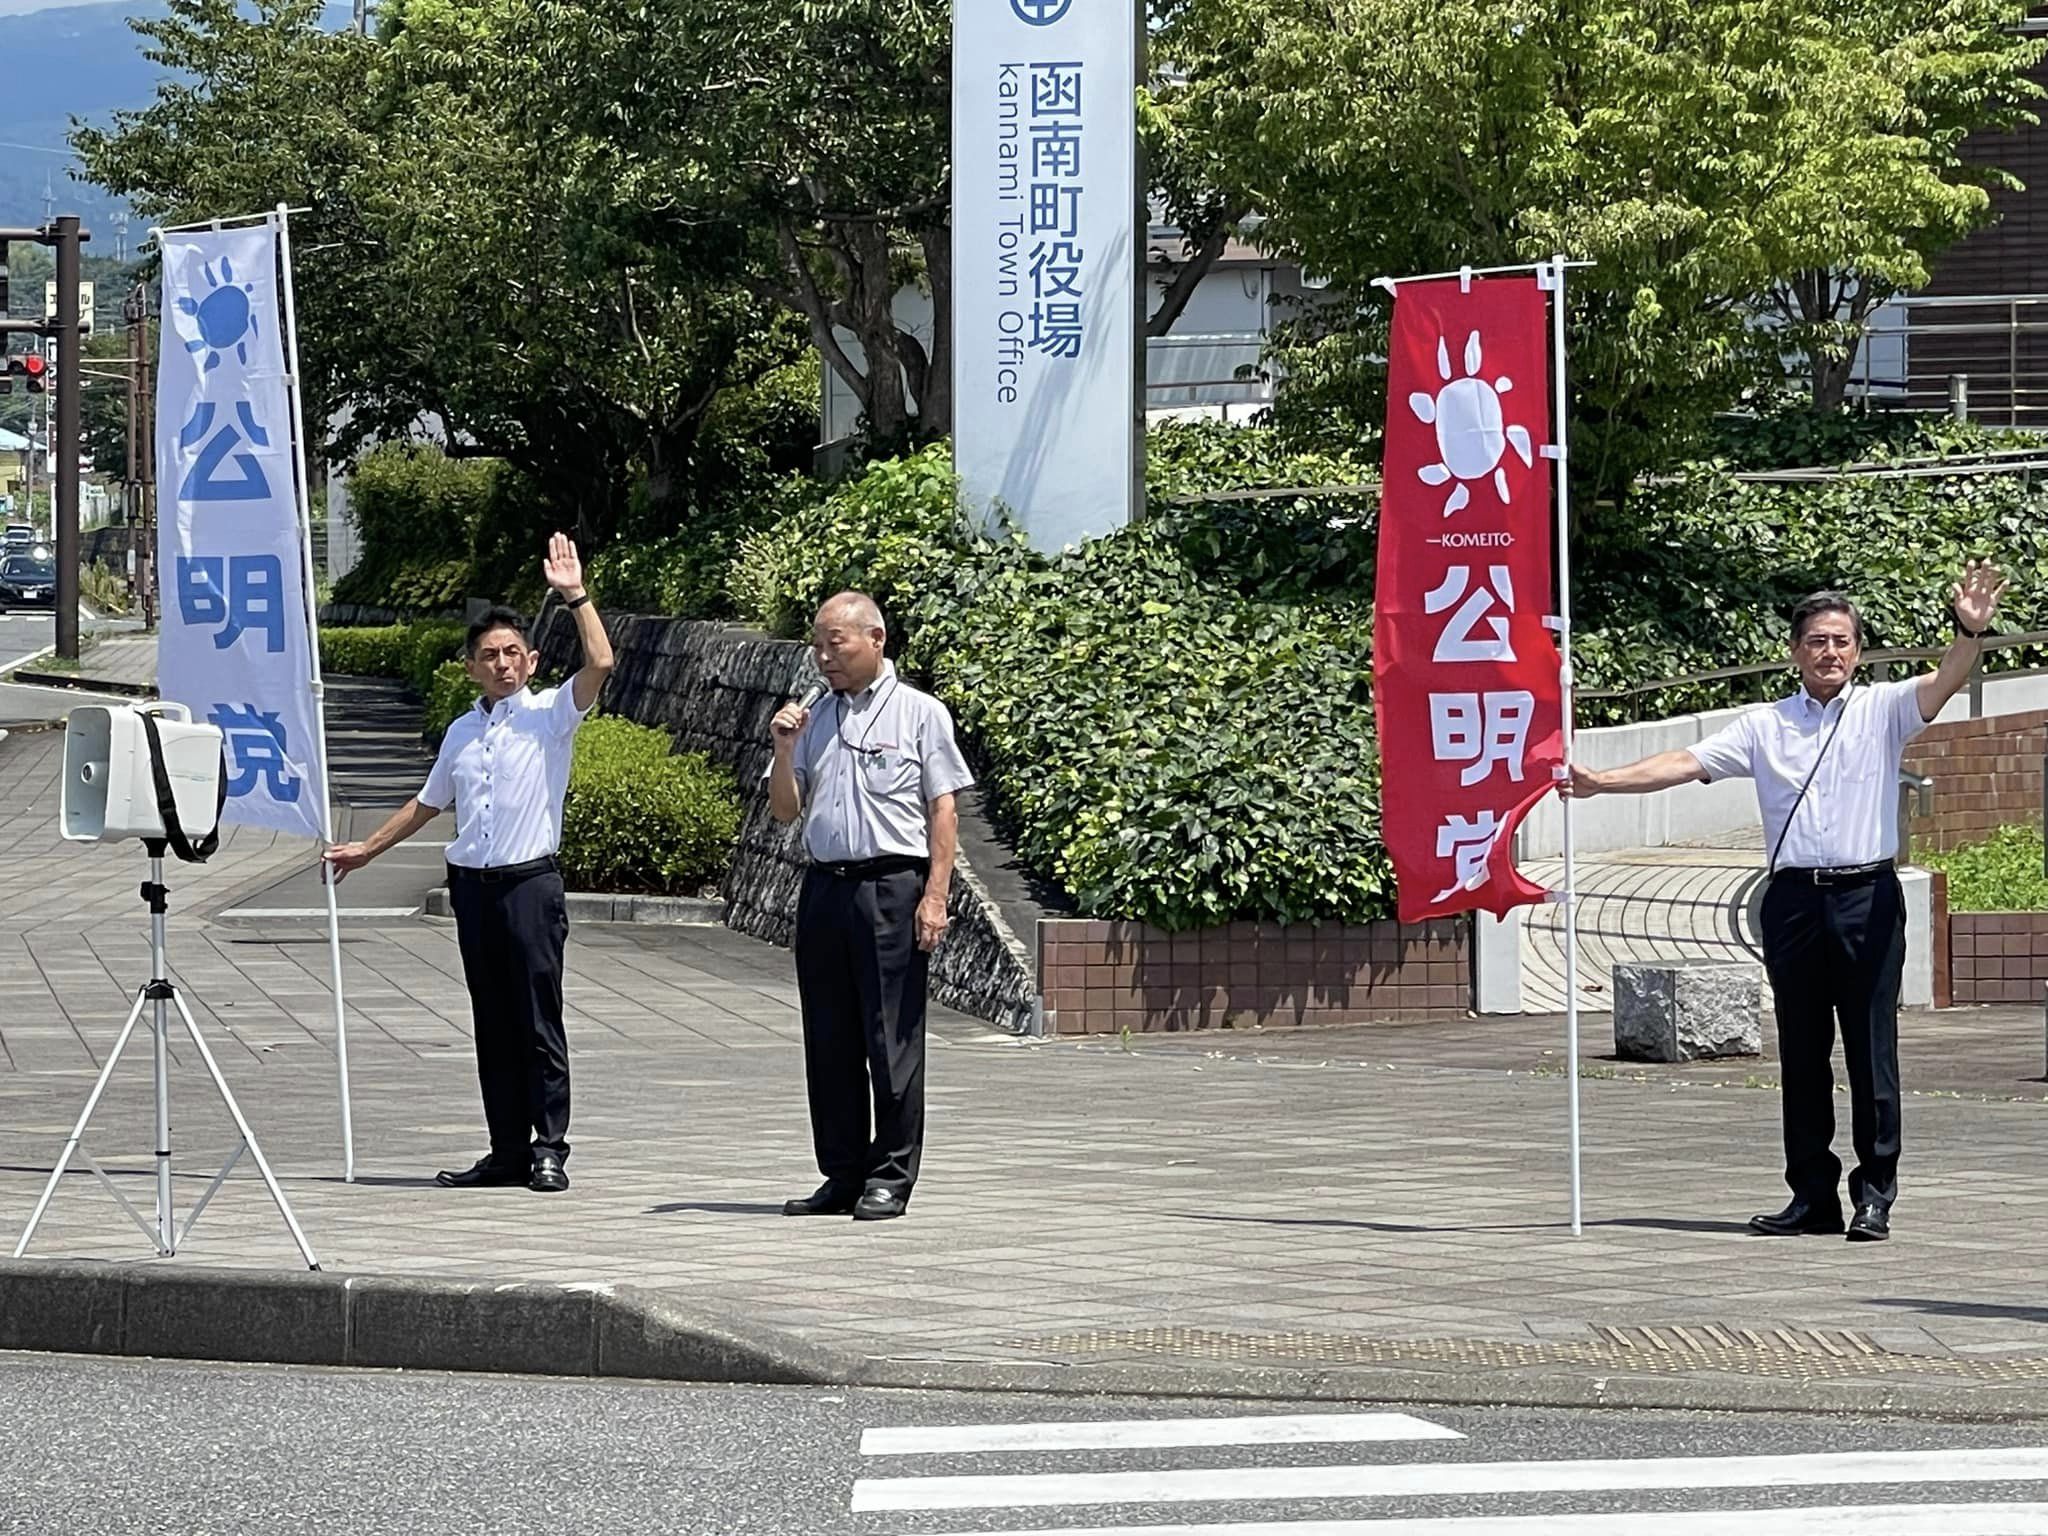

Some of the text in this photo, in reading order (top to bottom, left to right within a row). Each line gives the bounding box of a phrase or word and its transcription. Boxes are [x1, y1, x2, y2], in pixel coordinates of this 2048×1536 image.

[998, 63, 1024, 403] kannami Town Office
[1028, 61, 1083, 358] 函南町役場
[177, 401, 300, 803] 公明党
[1441, 532, 1512, 547] KOMEITO
[1424, 565, 1535, 903] 公明党
